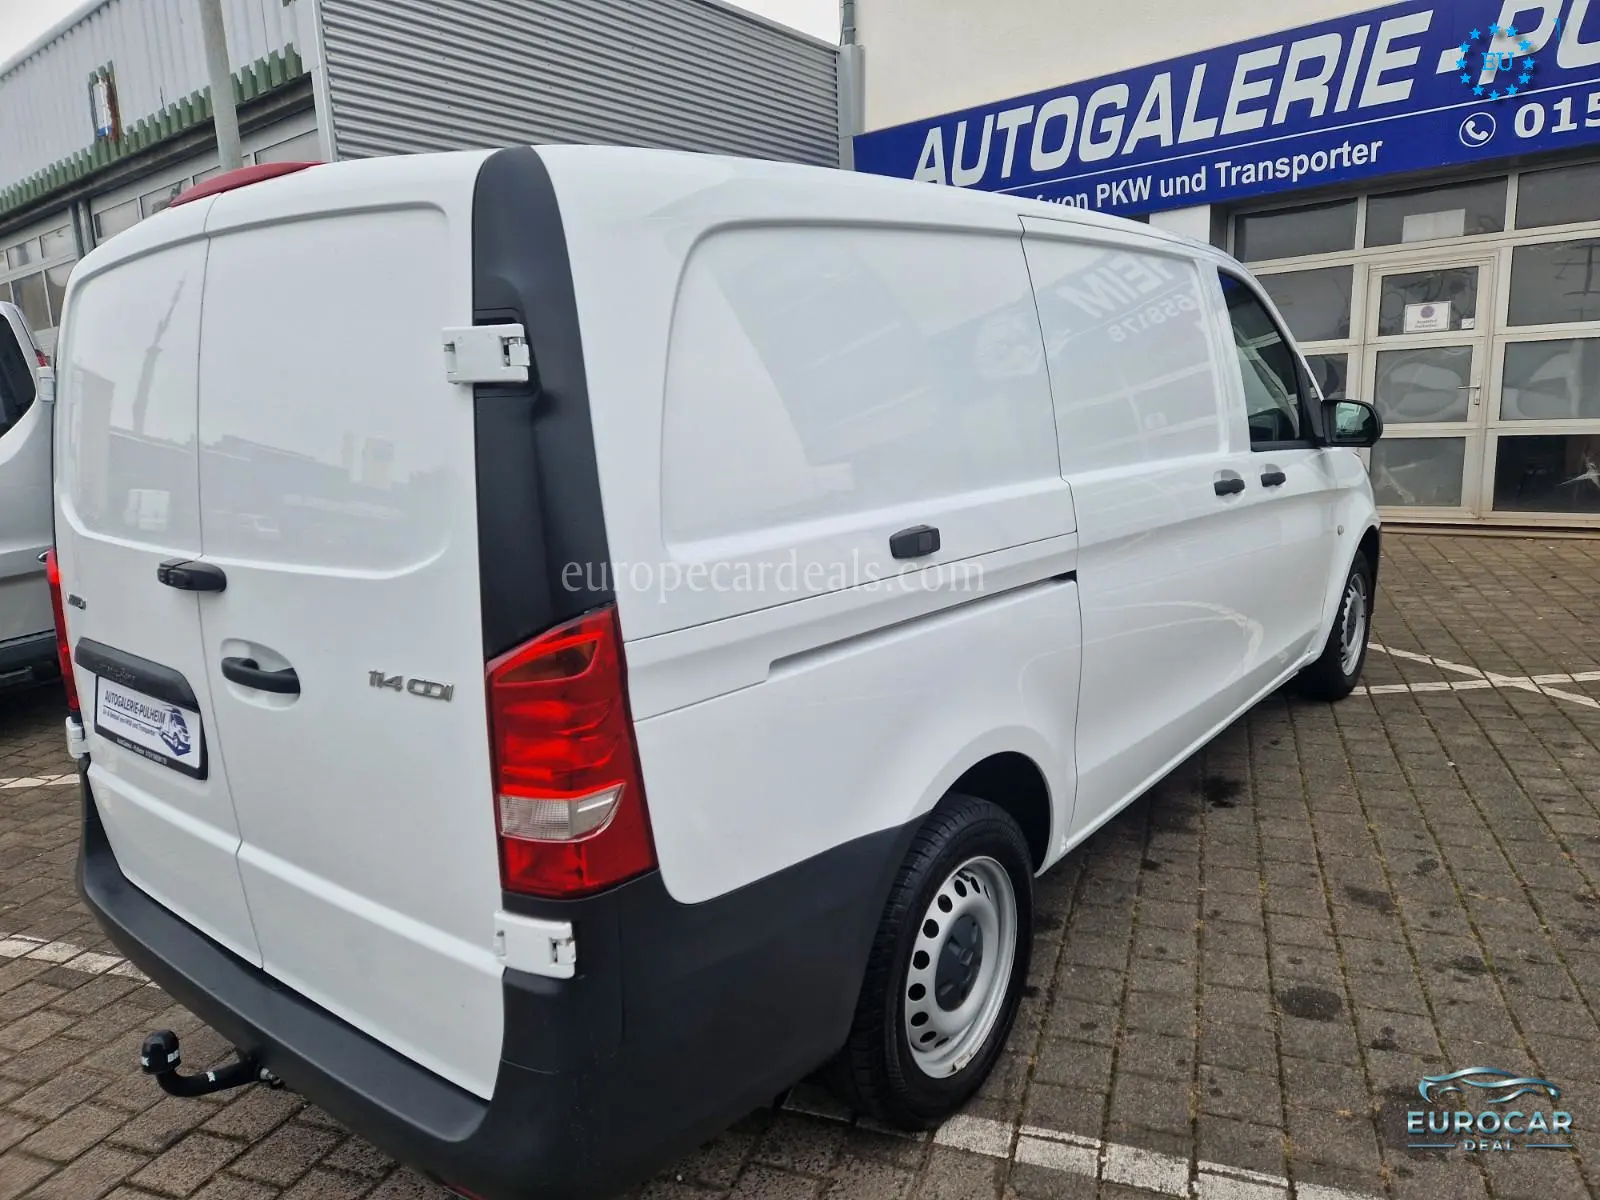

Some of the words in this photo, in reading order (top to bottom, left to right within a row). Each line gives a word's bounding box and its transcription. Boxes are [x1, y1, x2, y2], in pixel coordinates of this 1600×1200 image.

[1097, 174, 1153, 208] PKW
[1160, 165, 1207, 198] und
[1215, 140, 1383, 188] Transporter
[368, 670, 404, 692] 114
[407, 678, 454, 702] CDI
